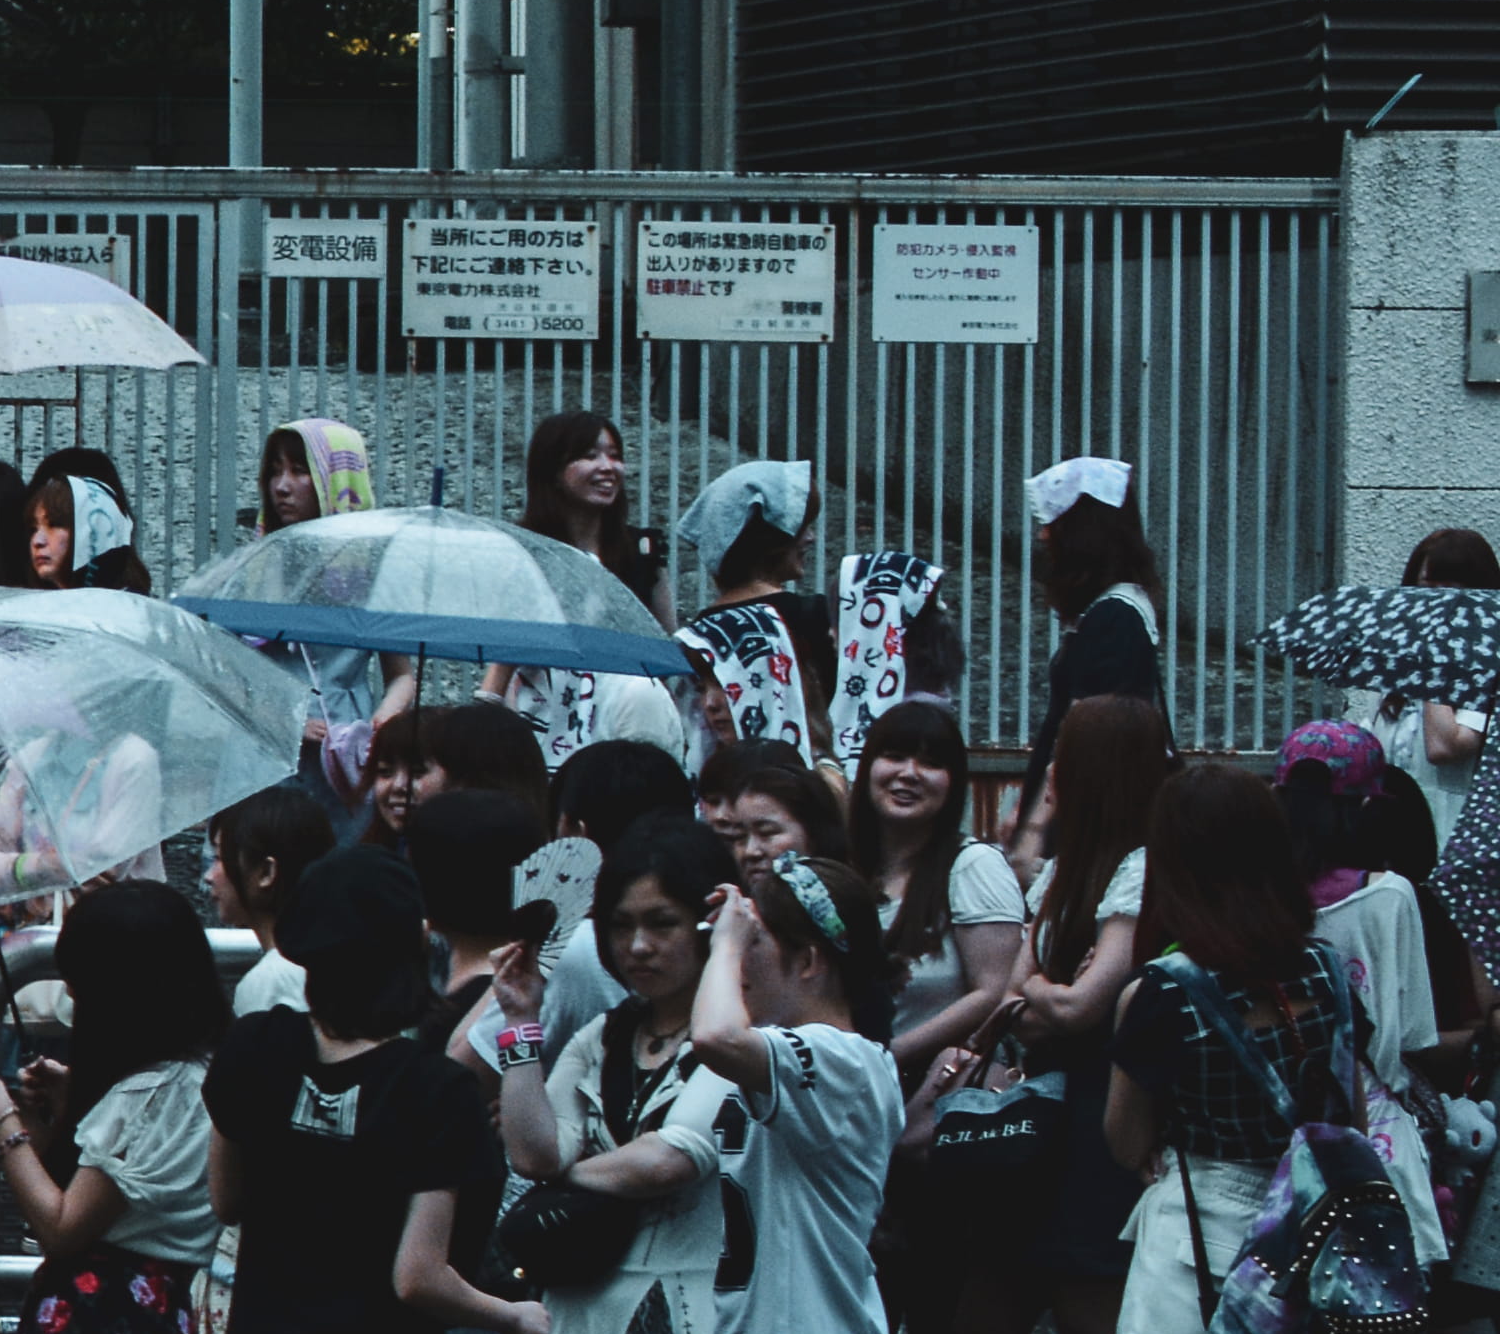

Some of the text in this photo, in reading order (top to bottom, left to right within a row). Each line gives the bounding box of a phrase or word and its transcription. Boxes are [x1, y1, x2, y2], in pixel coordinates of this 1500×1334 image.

[430, 228, 585, 248] 当所にご用の方は
[648, 231, 828, 252] この場所は緊急時自動車の
[272, 234, 378, 263] 変電設備
[411, 255, 593, 276] 下記にご連絡下さい。
[646, 255, 796, 274] 出入りがありますので
[913, 267, 1001, 280] センサー作動中
[417, 282, 541, 298] 東京電力株式会社
[646, 278, 736, 297] 駐車禁止です
